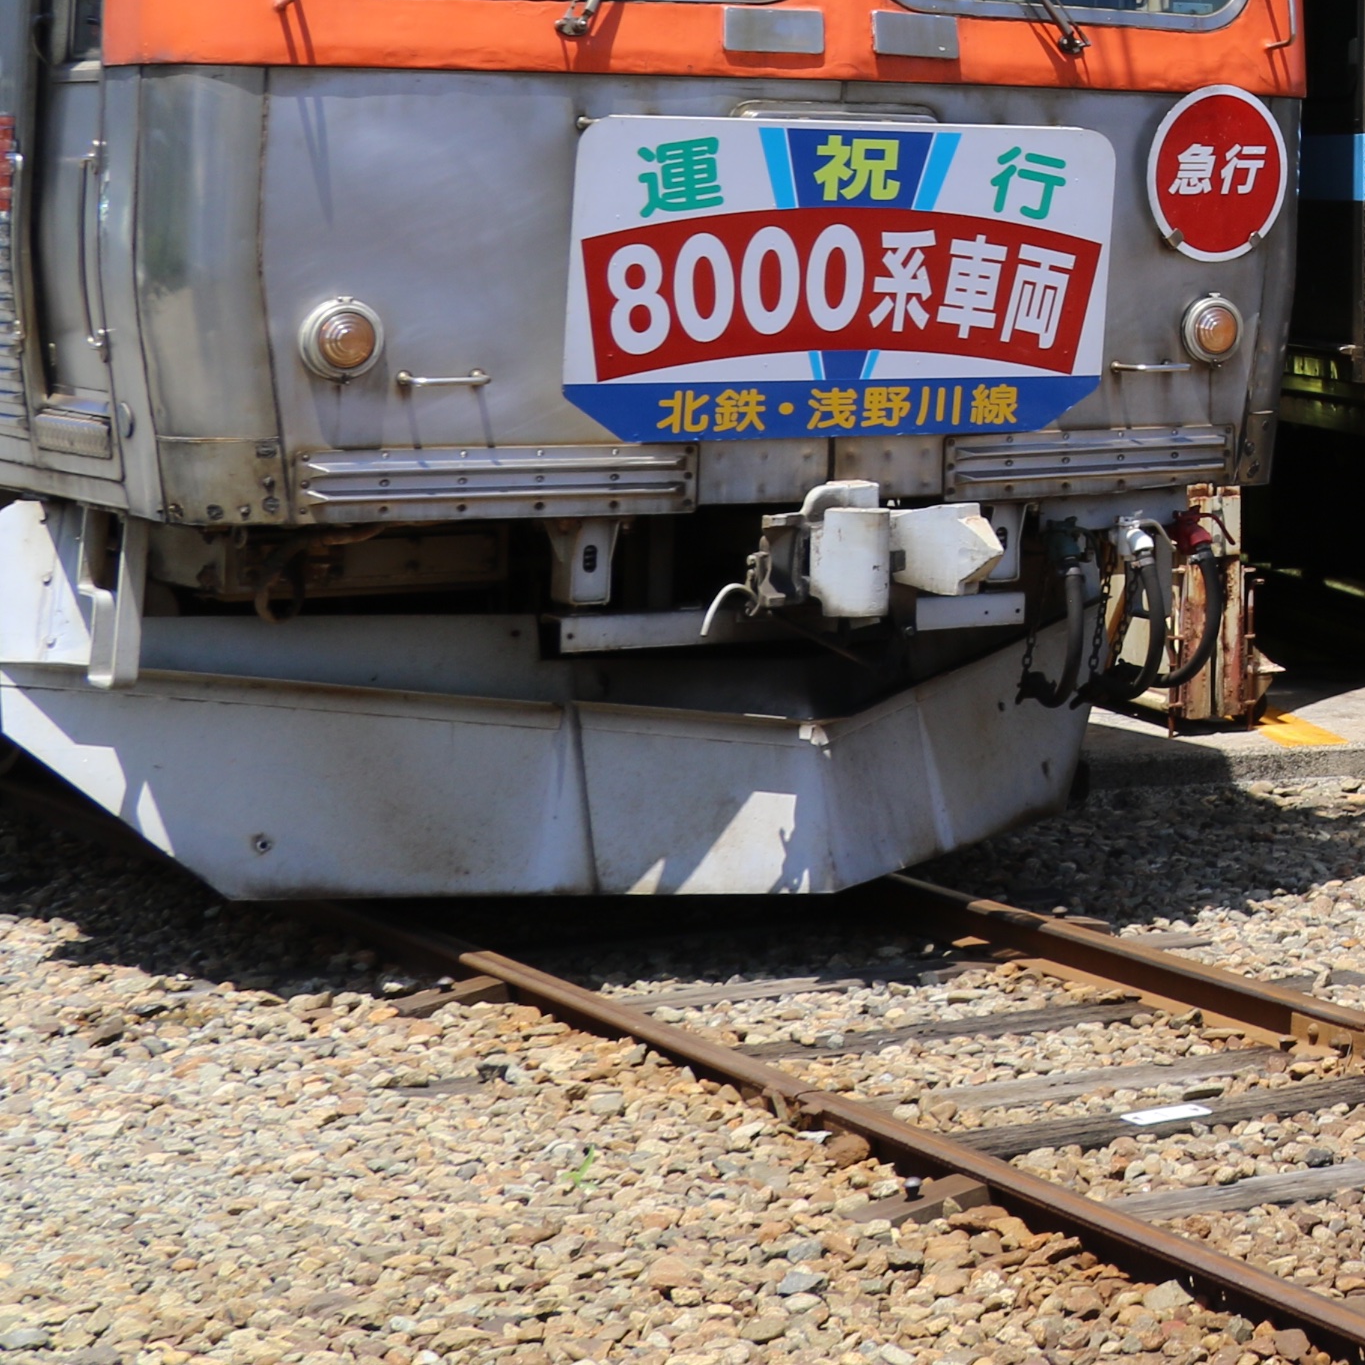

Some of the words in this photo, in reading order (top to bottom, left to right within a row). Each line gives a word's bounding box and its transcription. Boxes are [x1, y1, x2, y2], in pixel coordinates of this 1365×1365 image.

[637, 135, 725, 218] 運
[813, 134, 901, 201] 祝
[991, 145, 1067, 221] 行
[1168, 142, 1268, 197] 急行
[606, 223, 1076, 355] 8000系車両
[656, 383, 1019, 434] 北鉄・浅野川線
